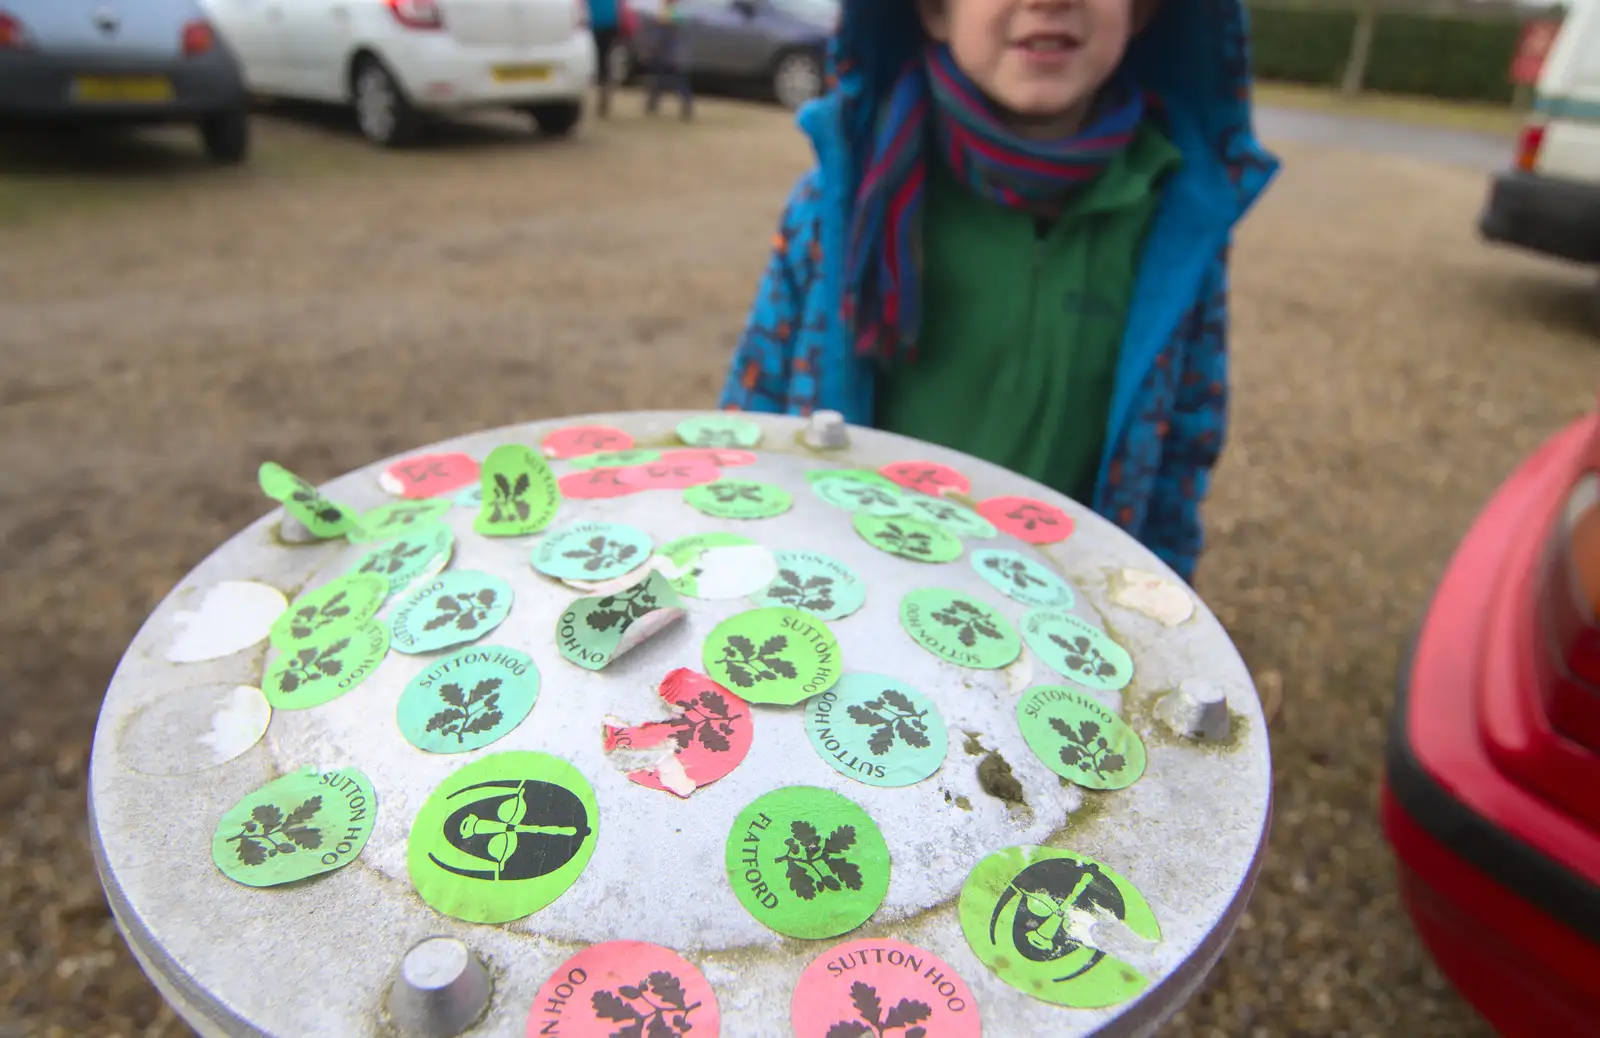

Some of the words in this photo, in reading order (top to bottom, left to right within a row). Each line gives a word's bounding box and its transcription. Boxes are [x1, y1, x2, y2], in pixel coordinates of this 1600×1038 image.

[561, 611, 581, 652] HOO
[780, 615, 833, 665] SUTTON
[419, 652, 491, 689] SUTTON
[493, 653, 527, 677] HOO
[802, 667, 832, 693] HOO
[815, 692, 838, 724] HOO
[1024, 689, 1075, 719] SUTTON
[816, 727, 887, 778] SUTTON
[318, 771, 367, 823] SUTTON
[321, 827, 362, 865] HOO
[741, 811, 780, 911] FLATFORD
[543, 967, 588, 1015] HOO
[826, 948, 924, 978] SUTTON
[923, 966, 966, 1012] HOO
